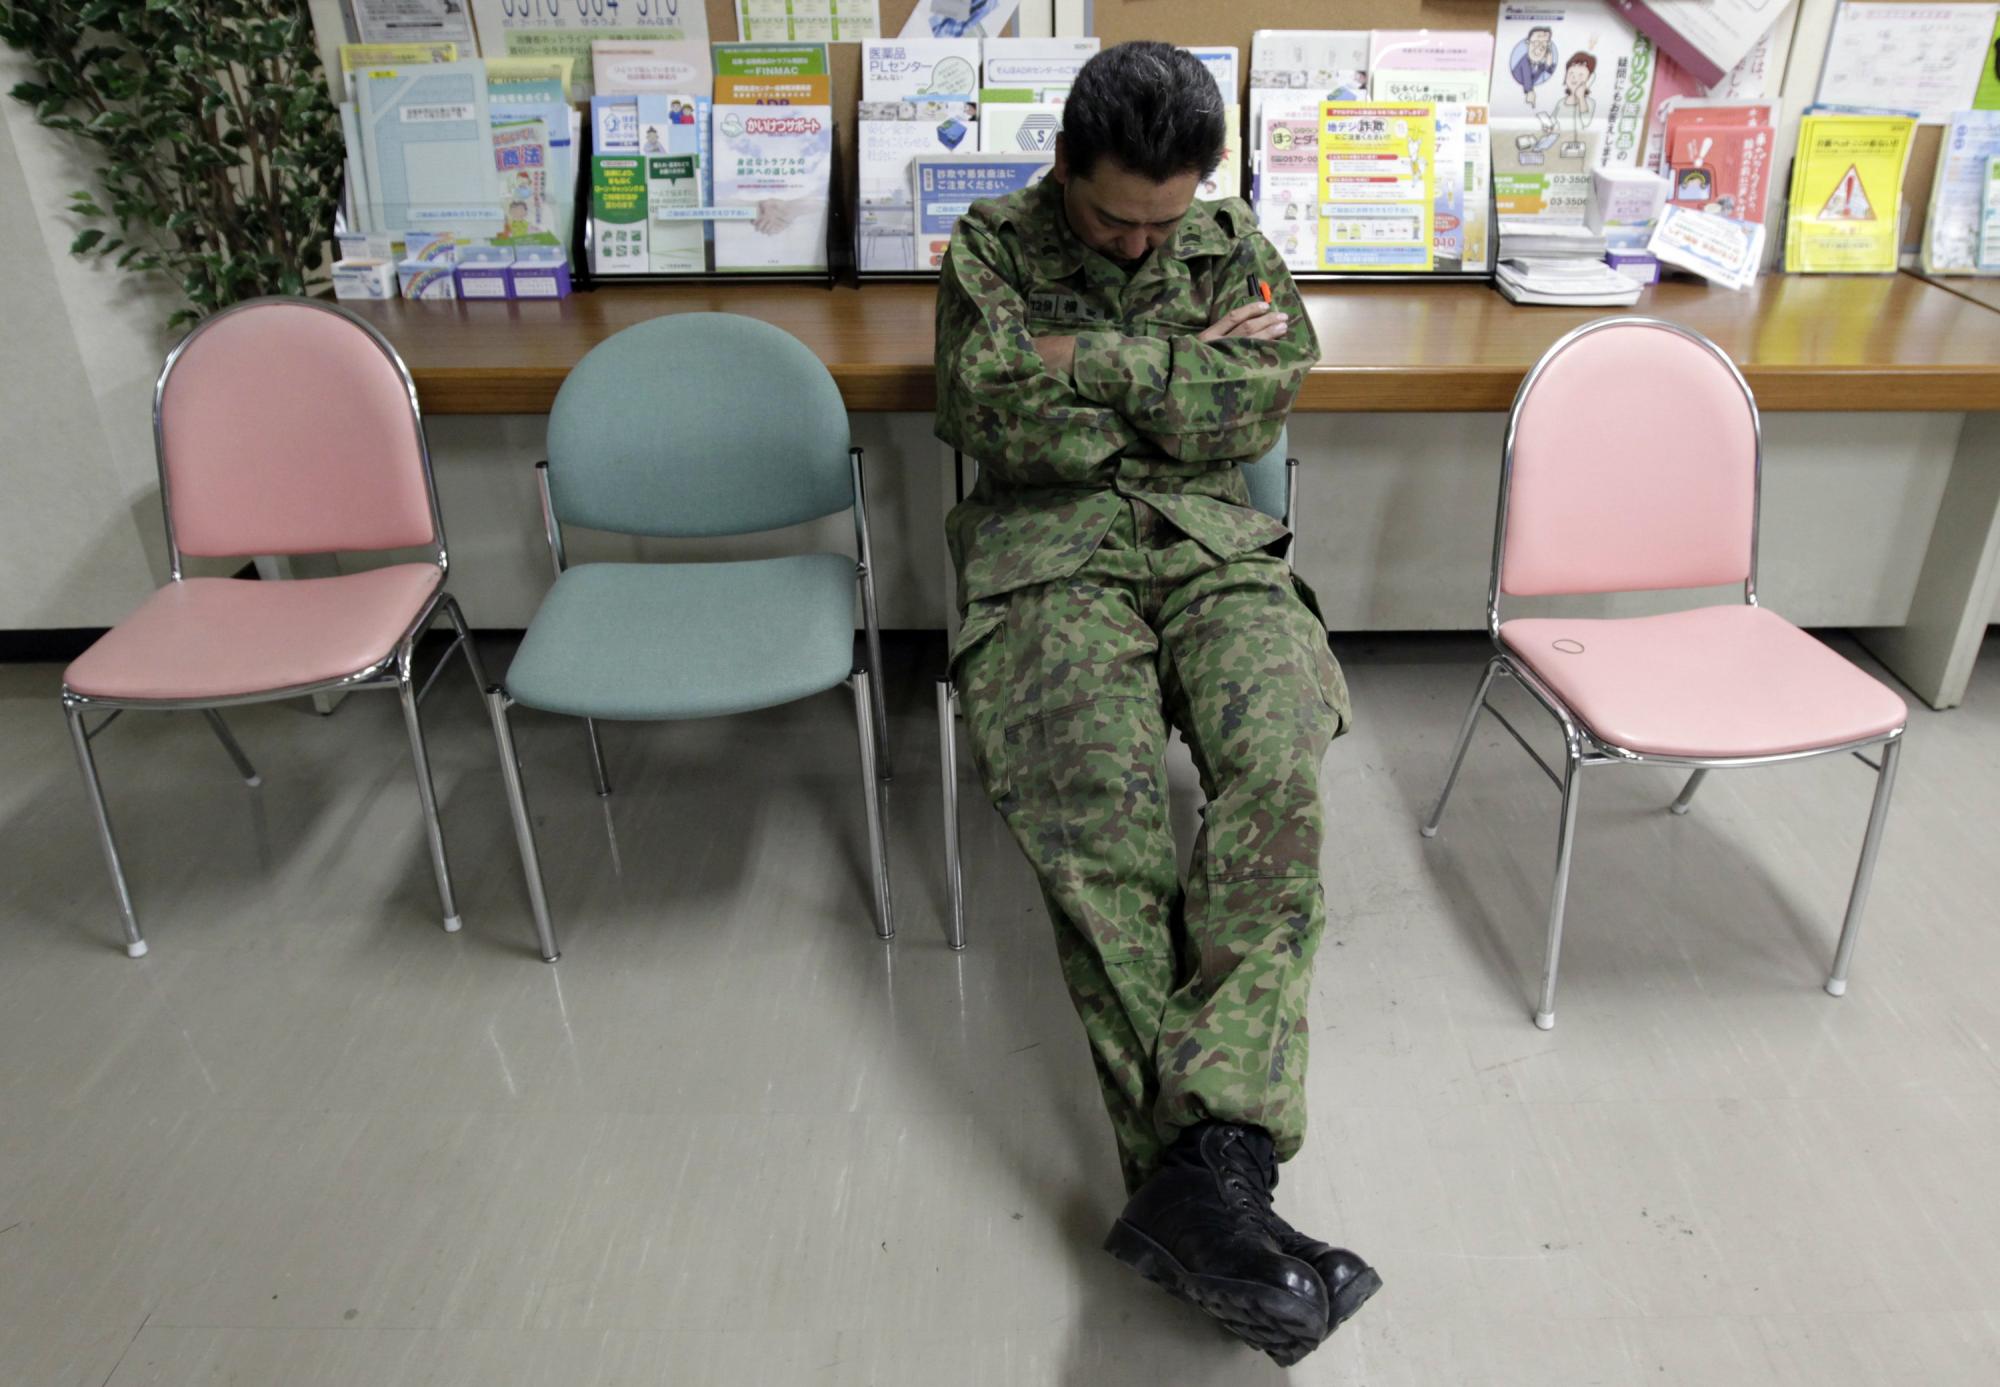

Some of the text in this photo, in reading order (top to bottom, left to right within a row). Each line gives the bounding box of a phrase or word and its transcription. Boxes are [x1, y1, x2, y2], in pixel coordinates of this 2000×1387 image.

[869, 47, 906, 59] 医薬品
[755, 66, 799, 75] FINMAC
[870, 60, 932, 72] PLセンター
[745, 117, 821, 134] かいけつサポート
[1037, 130, 1044, 143] S
[736, 158, 805, 166] 身近なトラブルの
